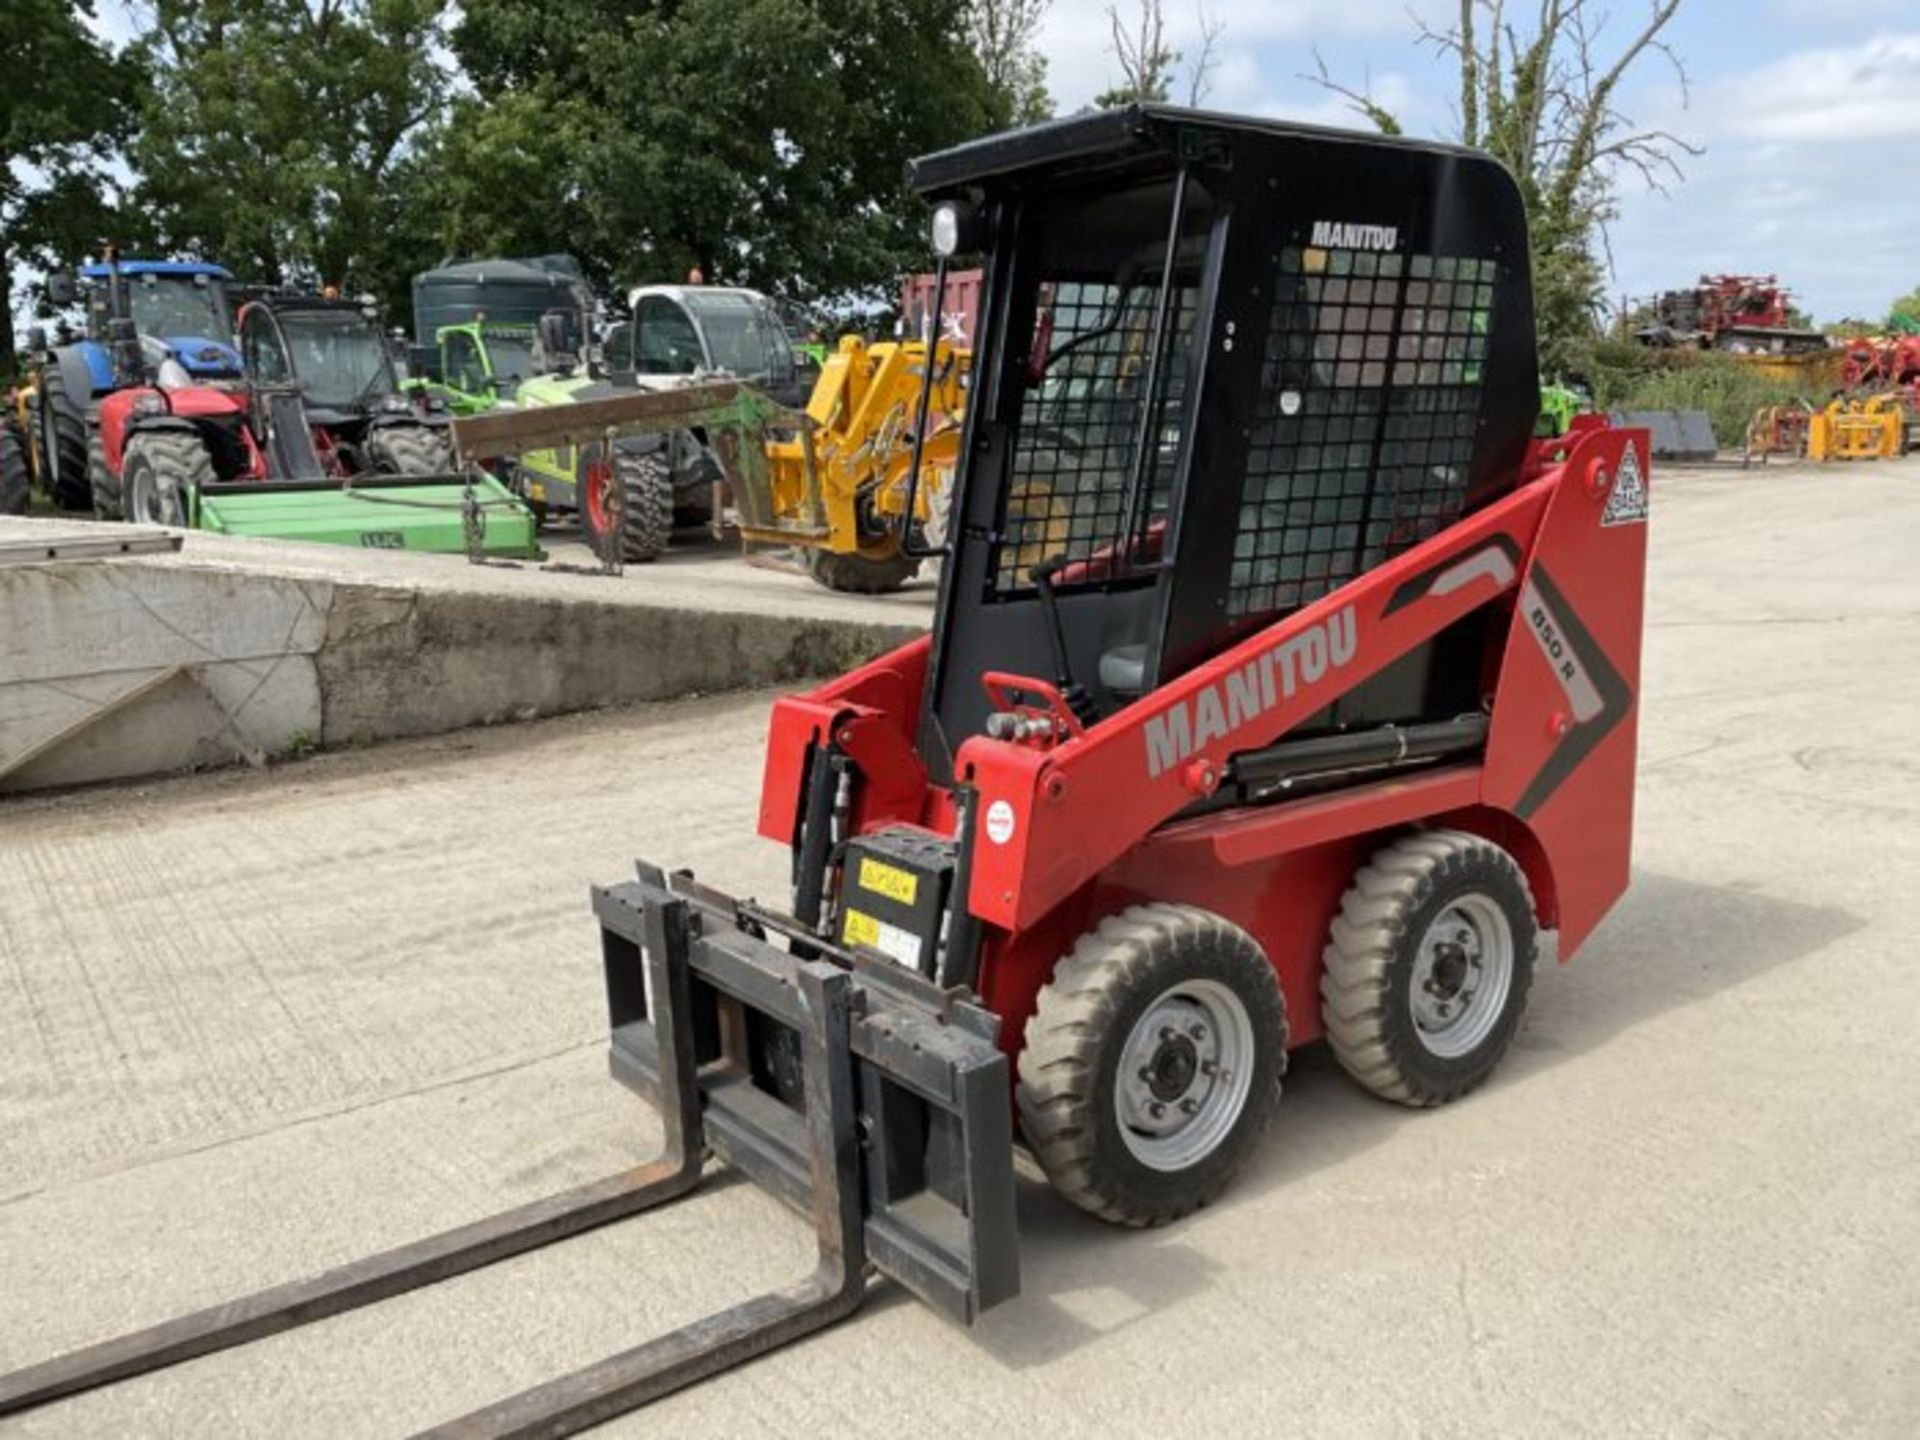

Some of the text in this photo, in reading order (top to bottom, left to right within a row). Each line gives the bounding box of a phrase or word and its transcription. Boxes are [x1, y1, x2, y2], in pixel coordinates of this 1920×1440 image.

[1311, 220, 1398, 251] MANITOU
[1532, 607, 1575, 681] 850 R
[1143, 602, 1358, 780] MANITOU
